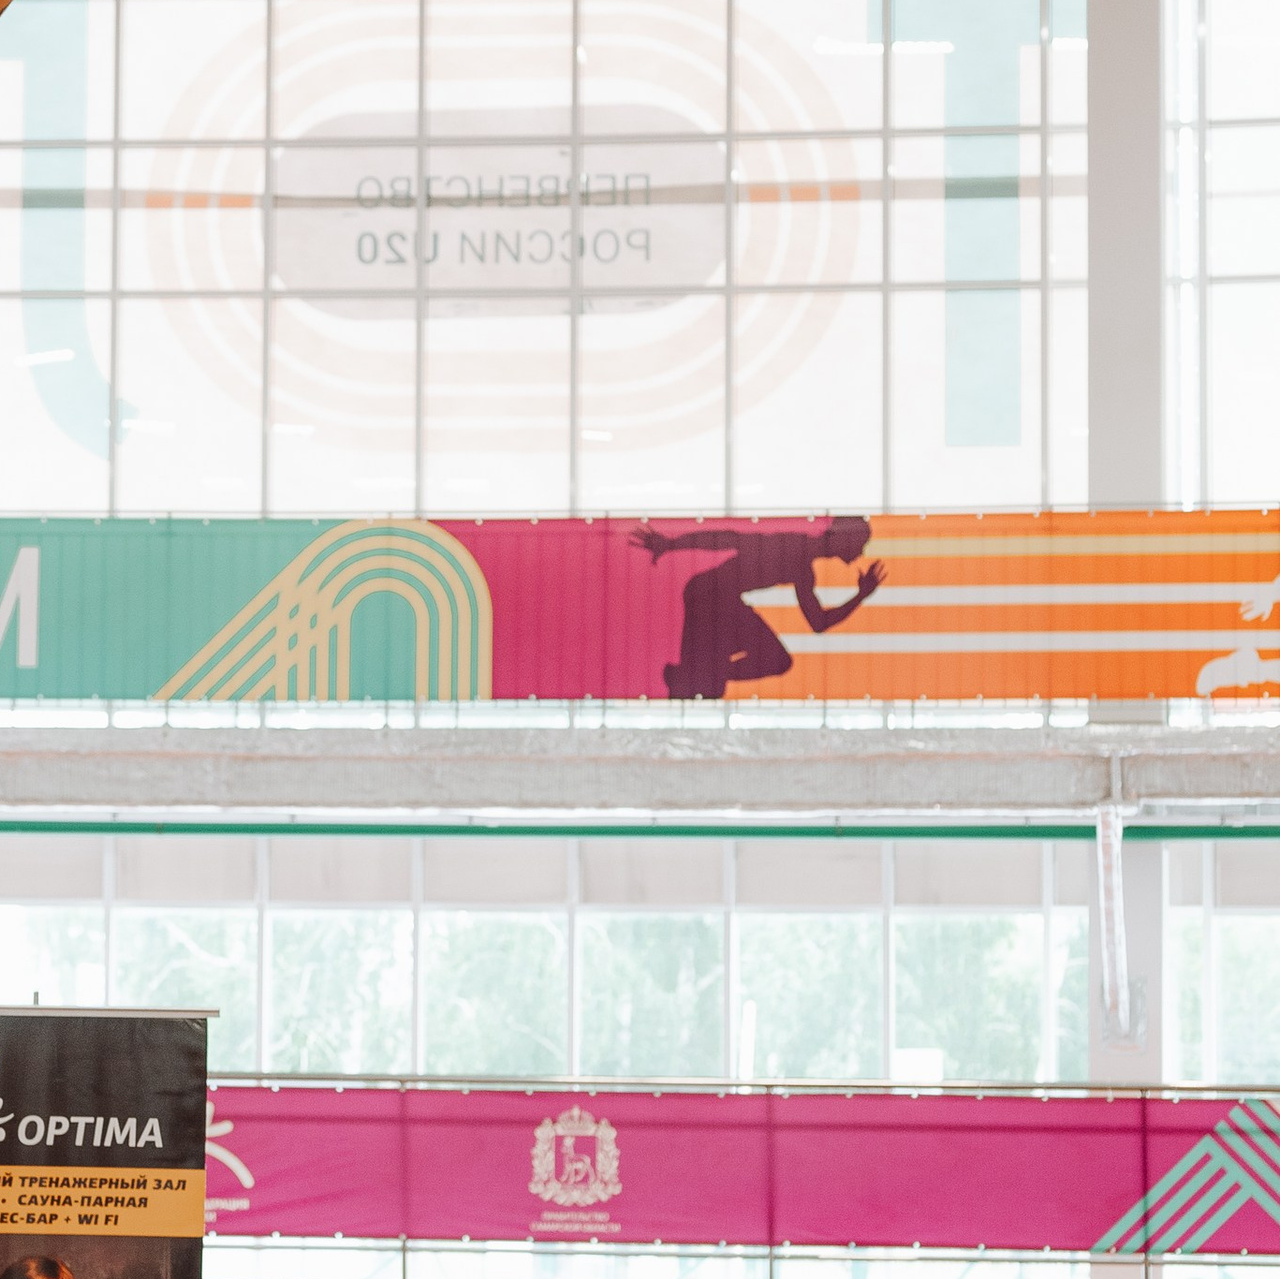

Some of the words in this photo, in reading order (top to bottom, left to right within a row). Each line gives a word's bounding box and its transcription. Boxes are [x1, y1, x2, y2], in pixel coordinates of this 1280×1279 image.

[17, 1114, 164, 1149] OPTIMA
[19, 1175, 148, 1190] ТРЕНАЖЕРНЫЙ
[153, 1179, 187, 1191] ЗАЛ
[17, 1194, 149, 1208] САУНА-ПАРНАЯ
[78, 1214, 99, 1225] WI
[104, 1214, 119, 1226] FI
